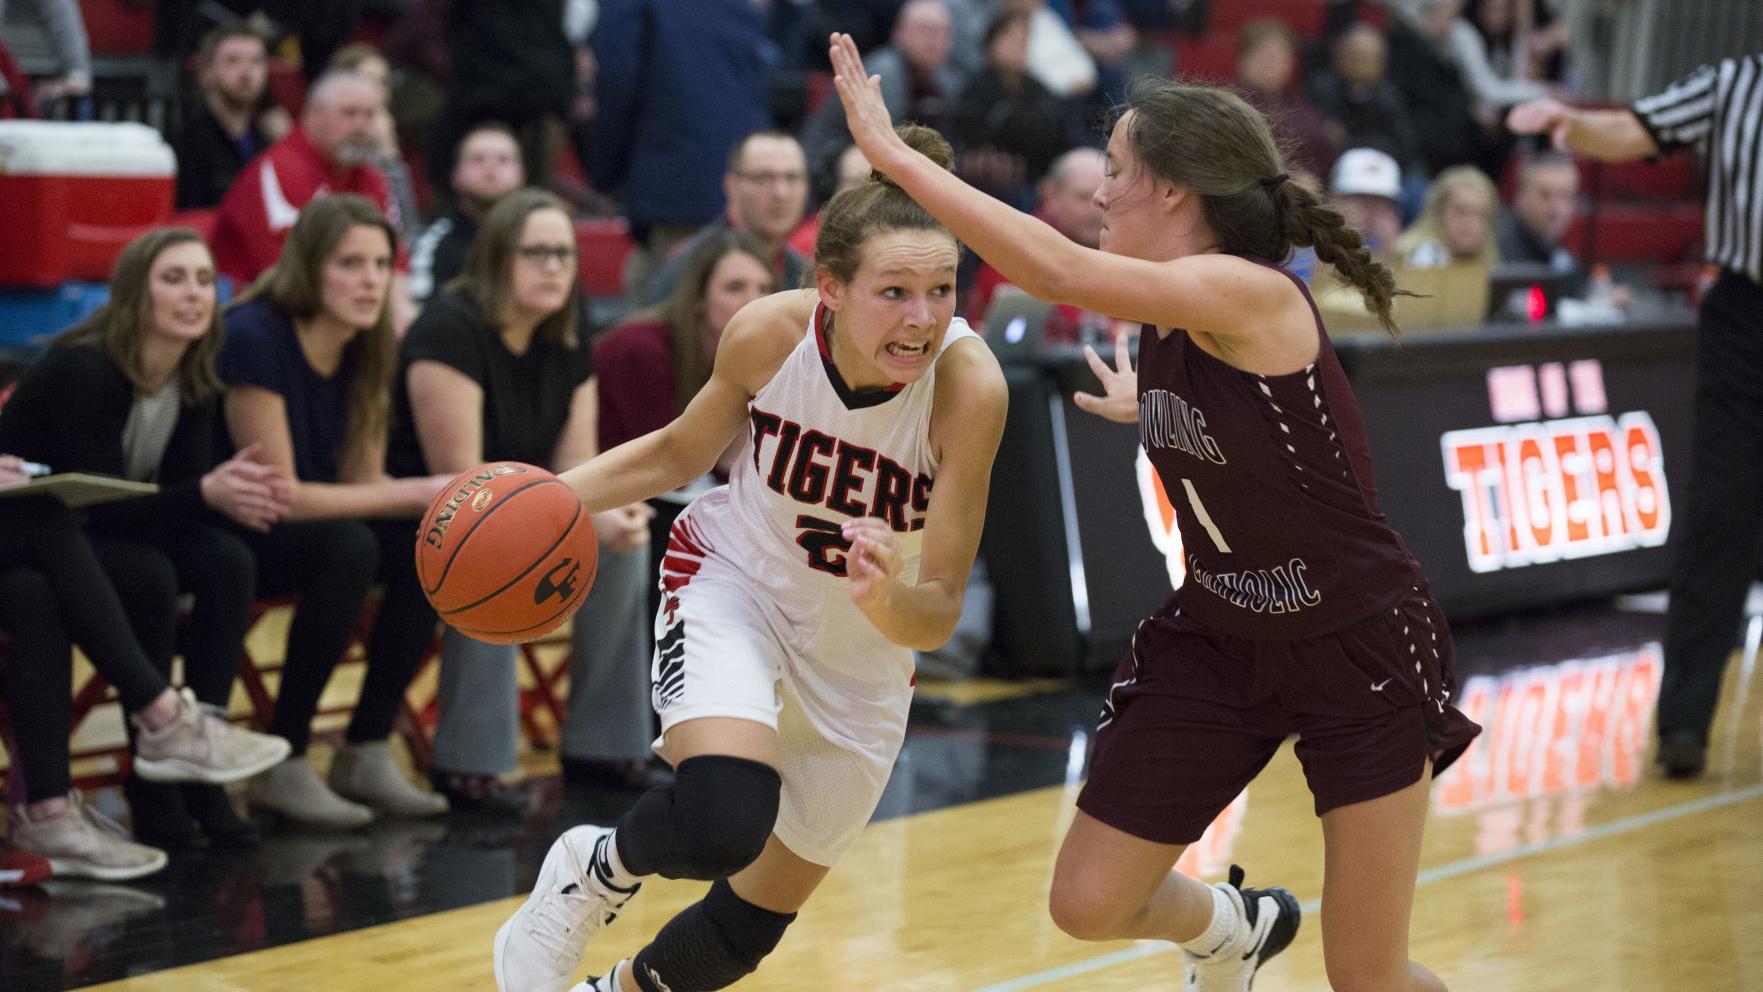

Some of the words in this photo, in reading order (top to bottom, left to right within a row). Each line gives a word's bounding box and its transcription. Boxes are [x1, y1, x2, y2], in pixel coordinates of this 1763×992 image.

[750, 405, 936, 532] TIGERS
[1138, 389, 1227, 464] OWLING
[1181, 479, 1232, 553] 1
[1440, 410, 1671, 573] TIGERS
